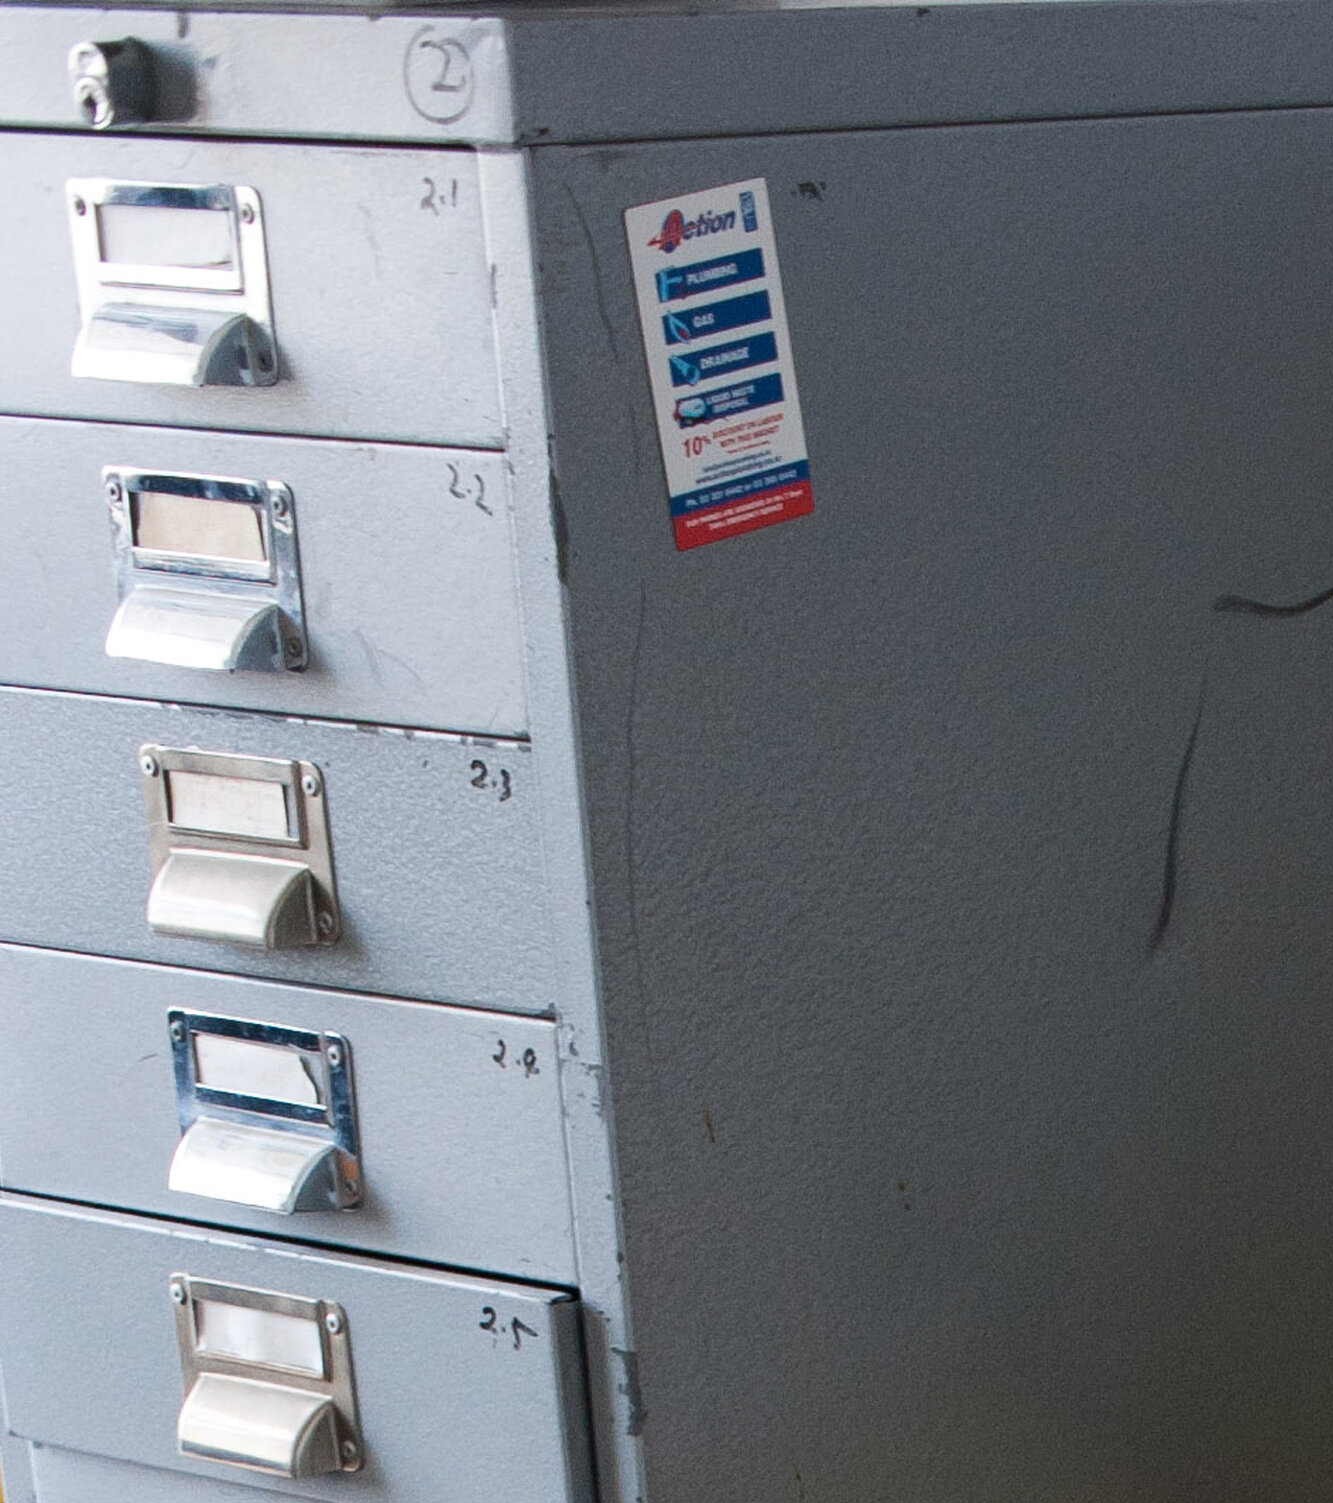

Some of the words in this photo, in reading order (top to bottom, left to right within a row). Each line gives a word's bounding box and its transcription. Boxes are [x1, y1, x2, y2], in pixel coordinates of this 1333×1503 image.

[418, 41, 474, 92] 2
[420, 178, 459, 213] 2.1
[448, 461, 494, 517] 2.2
[469, 760, 513, 801] 2.3
